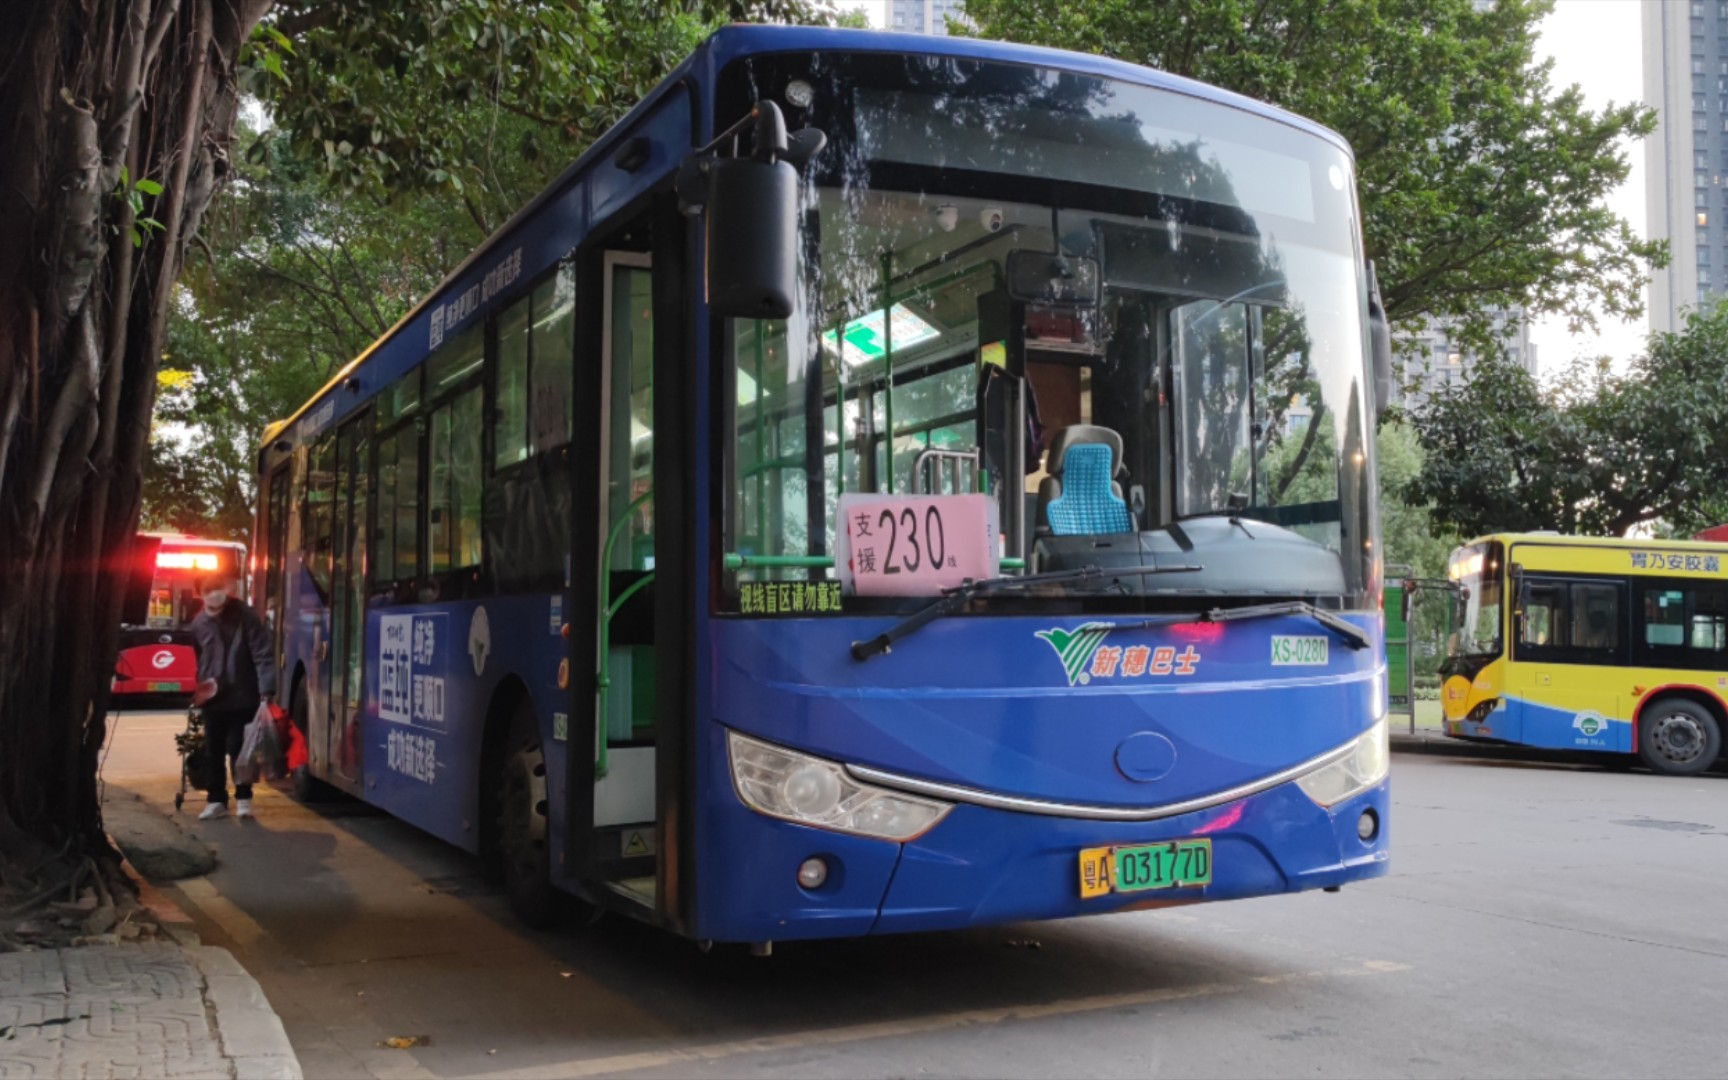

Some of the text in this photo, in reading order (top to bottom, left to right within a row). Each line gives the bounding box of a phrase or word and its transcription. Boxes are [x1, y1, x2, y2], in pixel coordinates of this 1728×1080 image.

[854, 511, 877, 575] 支援
[878, 505, 945, 575] 230
[740, 581, 842, 614] 视线盲区请勿靠近
[1091, 646, 1199, 676] 新穗巴士
[1272, 637, 1327, 664] XS-0280
[1122, 844, 1208, 886] 03177D
